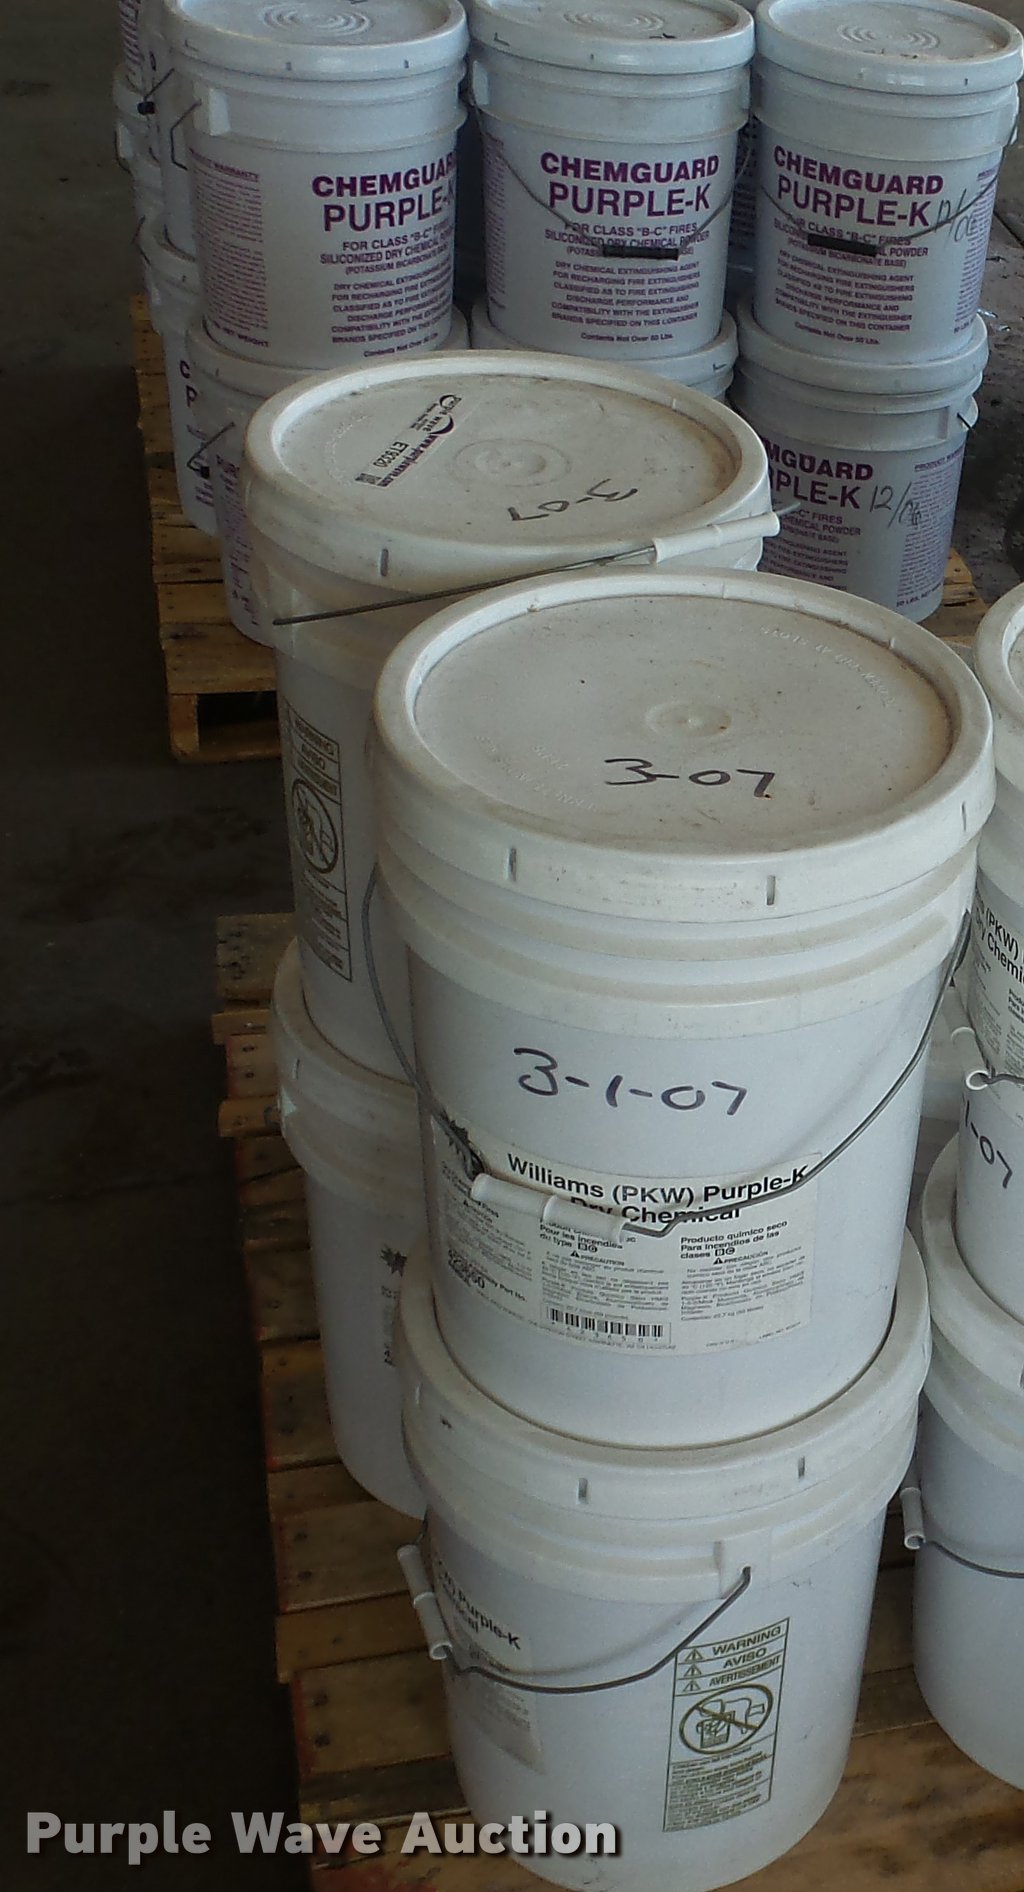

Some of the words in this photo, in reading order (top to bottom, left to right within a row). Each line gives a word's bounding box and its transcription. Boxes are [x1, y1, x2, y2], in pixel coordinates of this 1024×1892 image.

[312, 152, 456, 197] CHEMGUAR
[540, 152, 719, 183] CHEMGUARD
[773, 145, 944, 195] CHEMGUARD
[548, 181, 711, 217] PURPLE-K
[778, 174, 932, 227] PURPLE-K
[594, 224, 634, 237] CLASS
[669, 223, 697, 233] FIRES
[808, 221, 843, 238] CLASS
[343, 241, 367, 251] FOR
[372, 235, 408, 249] CLASS
[890, 247, 928, 256] POWDER
[320, 252, 382, 264] SILICONIZED
[386, 250, 402, 260] DRY
[573, 264, 616, 274] CHEMICAL
[353, 280, 394, 290] CHEMICAL
[823, 523, 861, 536] POWDER
[514, 1048, 747, 1116] 3-1-07
[507, 1153, 604, 1199] Williams
[612, 1184, 695, 1207] (PKW)
[703, 1164, 809, 1203] Purple-K
[540, 1224, 559, 1236] Pour
[681, 1234, 725, 1244] Producto
[766, 1220, 788, 1231] seco
[554, 1237, 572, 1247] type
[681, 1243, 702, 1252] Para
[752, 1233, 765, 1242] de
[712, 1626, 781, 1656] WARNING
[723, 1647, 767, 1669] AVISO
[709, 1654, 781, 1686] AVERTISSEMENT
